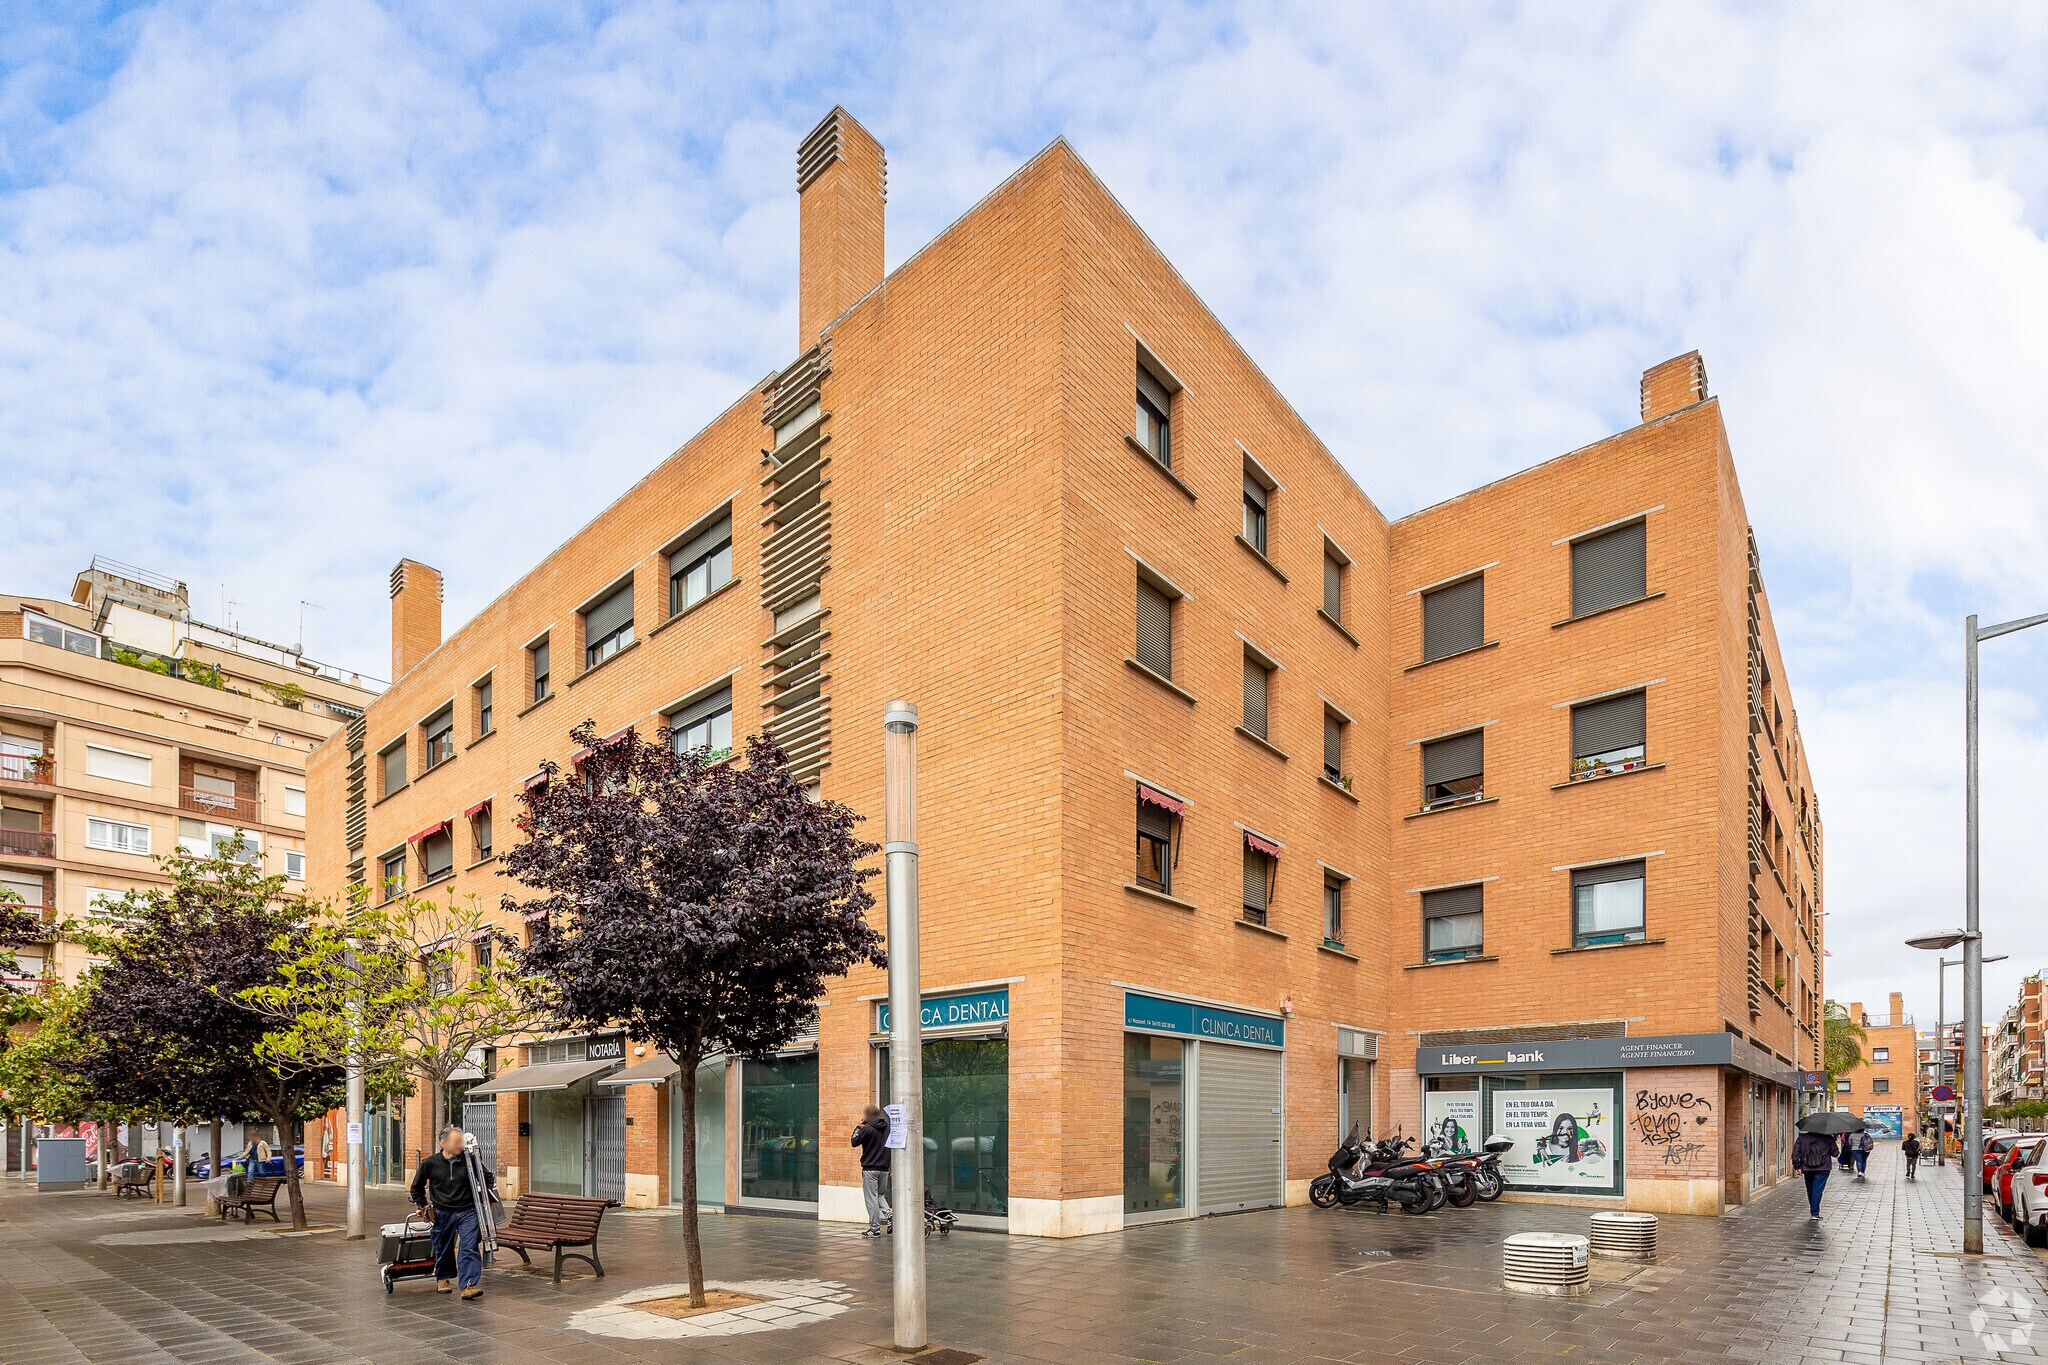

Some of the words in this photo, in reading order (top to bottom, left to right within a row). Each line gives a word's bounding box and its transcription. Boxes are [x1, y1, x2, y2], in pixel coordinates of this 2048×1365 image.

[949, 1000, 1009, 1022] DENTAL
[1201, 1018, 1240, 1038] CLINICA
[1243, 1024, 1275, 1043] DENTAL
[590, 1039, 620, 1058] NOTARÍA
[1441, 1054, 1477, 1066] Liber
[1507, 1050, 1544, 1063] bank
[1650, 1049, 1695, 1057] FINANCIERO
